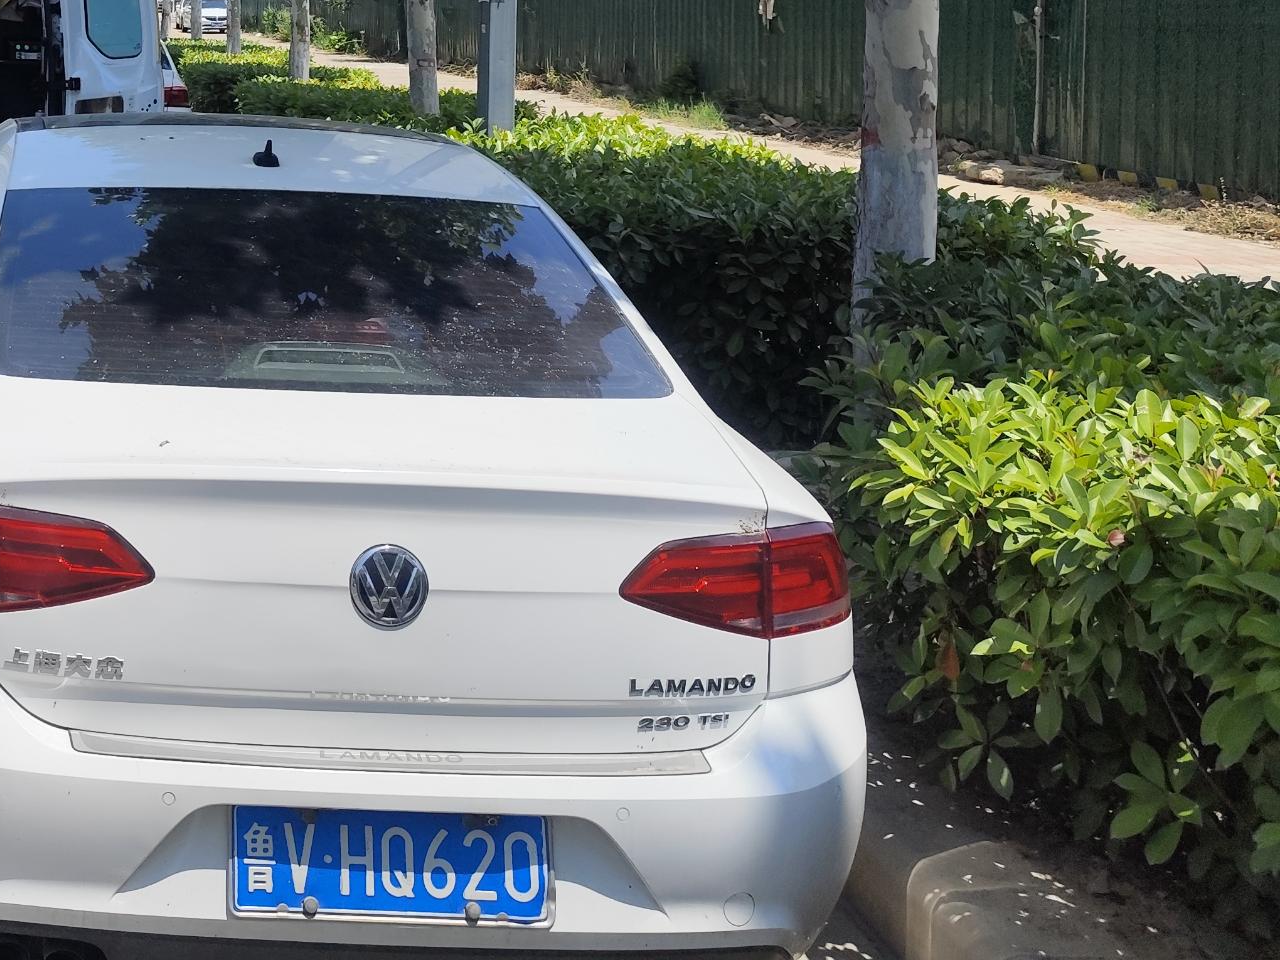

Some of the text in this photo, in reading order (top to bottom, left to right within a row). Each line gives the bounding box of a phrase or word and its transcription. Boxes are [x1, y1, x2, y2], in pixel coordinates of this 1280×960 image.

[1, 646, 124, 680] 上海大众
[629, 673, 756, 697] LAMANDO
[637, 716, 690, 732] 230
[319, 750, 463, 763] LAMANDO
